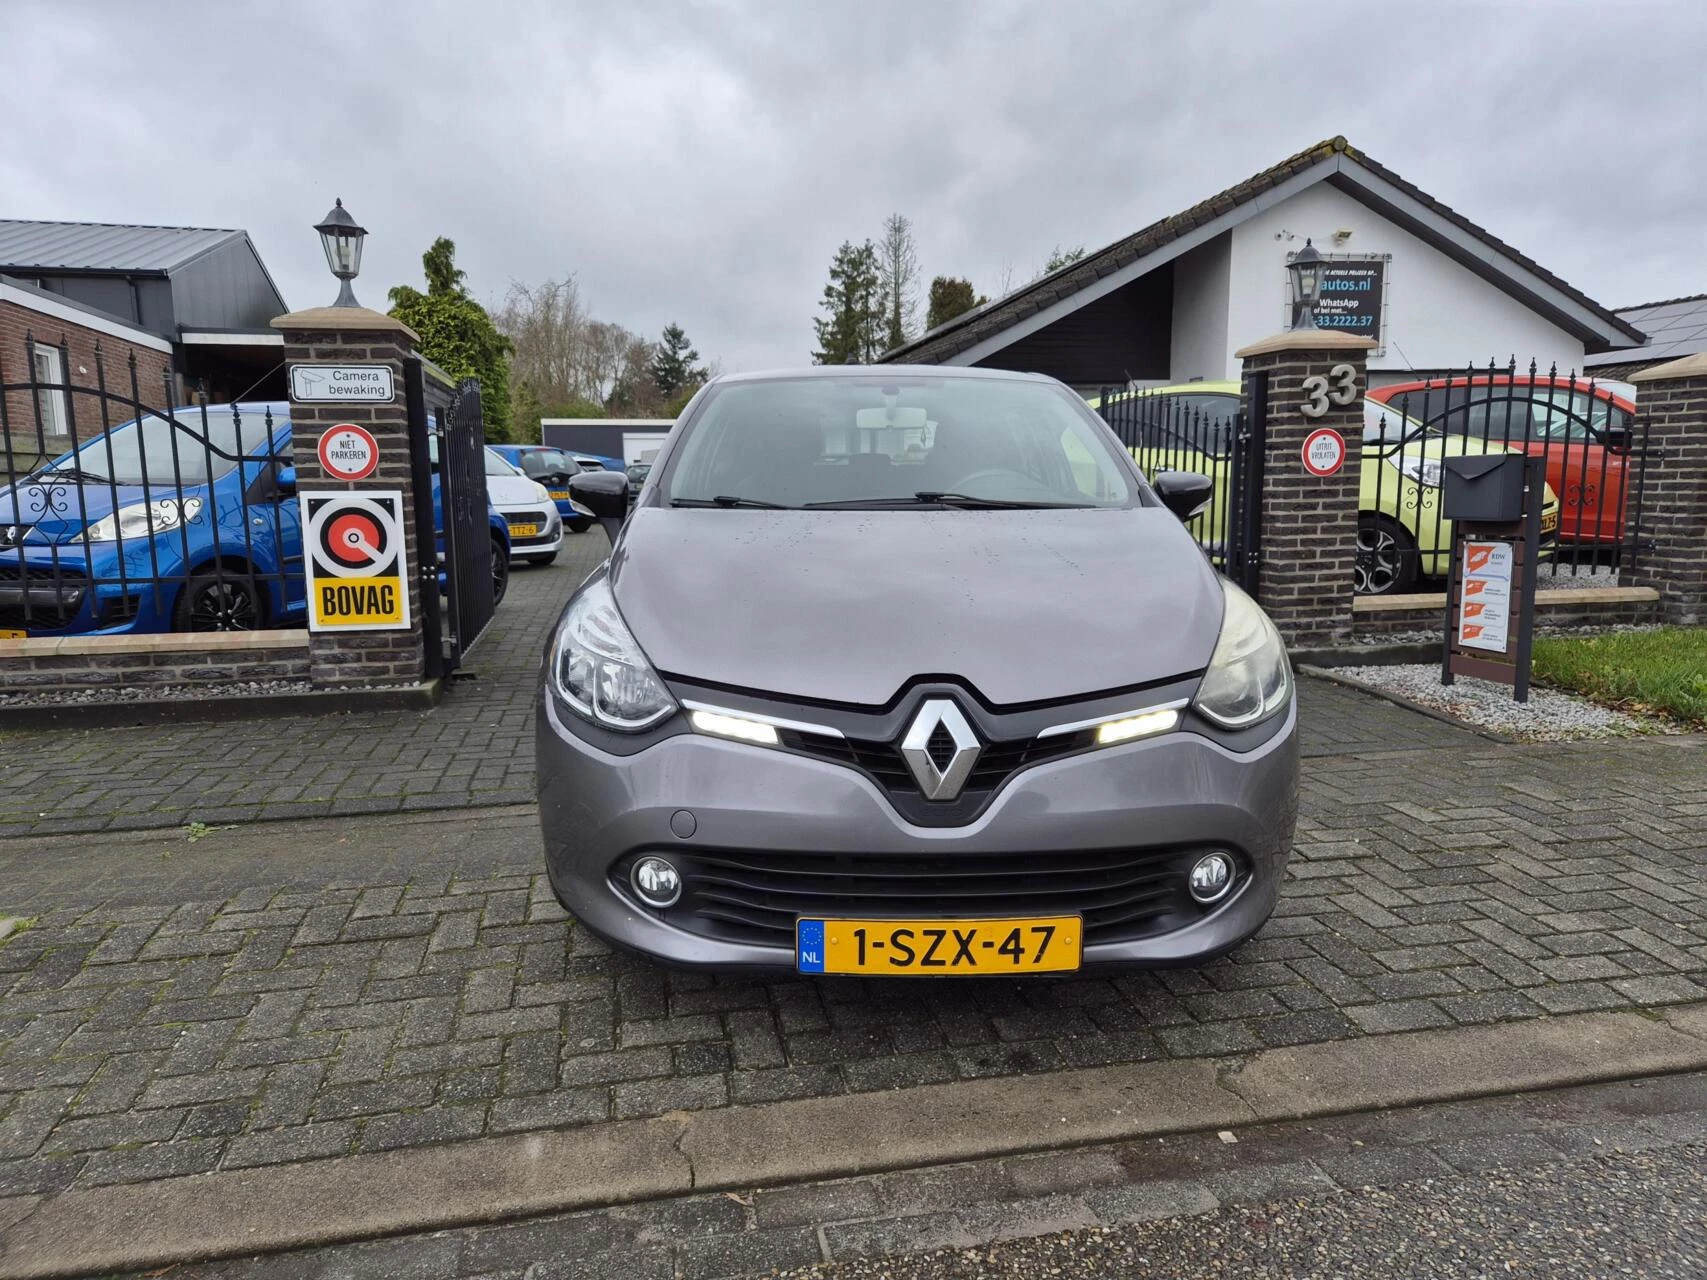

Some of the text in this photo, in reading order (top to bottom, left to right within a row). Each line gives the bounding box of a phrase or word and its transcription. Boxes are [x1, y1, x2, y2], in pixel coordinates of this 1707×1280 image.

[1319, 298, 1359, 308] WhatsApp
[1312, 315, 1373, 327] -33.2222.37
[332, 370, 379, 381] Camera
[328, 384, 386, 397] bewaking
[1300, 363, 1357, 417] 33
[339, 440, 356, 449] NIET
[1316, 442, 1333, 451] UITRIT
[331, 450, 367, 460] PARKEREN
[322, 584, 395, 616] BOVAG
[853, 925, 1056, 967] 1-SZX-47
[802, 951, 821, 963] NL
